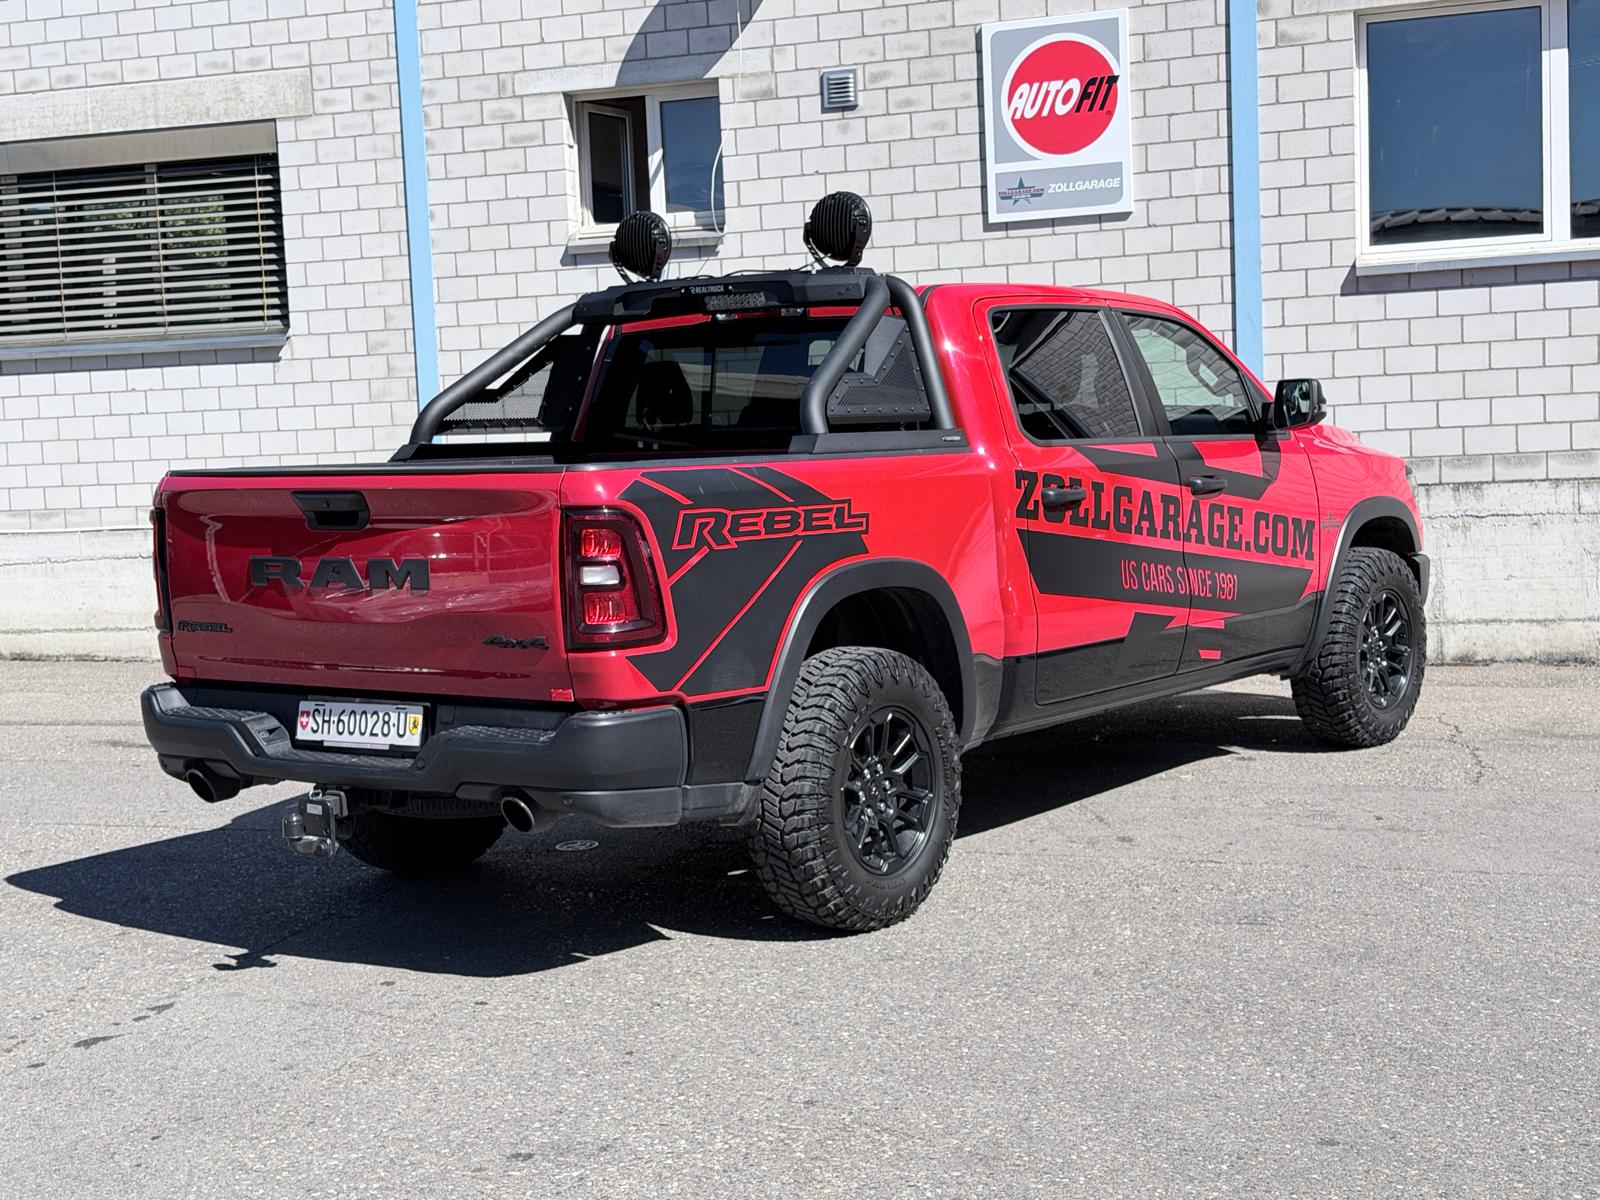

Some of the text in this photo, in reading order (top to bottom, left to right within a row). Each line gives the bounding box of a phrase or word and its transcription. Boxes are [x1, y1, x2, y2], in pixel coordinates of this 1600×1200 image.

[1008, 75, 1120, 120] AUTOFIT
[1048, 177, 1121, 193] ZOLLGARAGE
[671, 501, 869, 550] REBEL
[1014, 469, 1316, 561] ZOLLGARAGE.COM
[249, 555, 431, 591] RAM
[1121, 559, 1239, 601] US CARS SINCE 1981
[178, 620, 233, 633] REBEL
